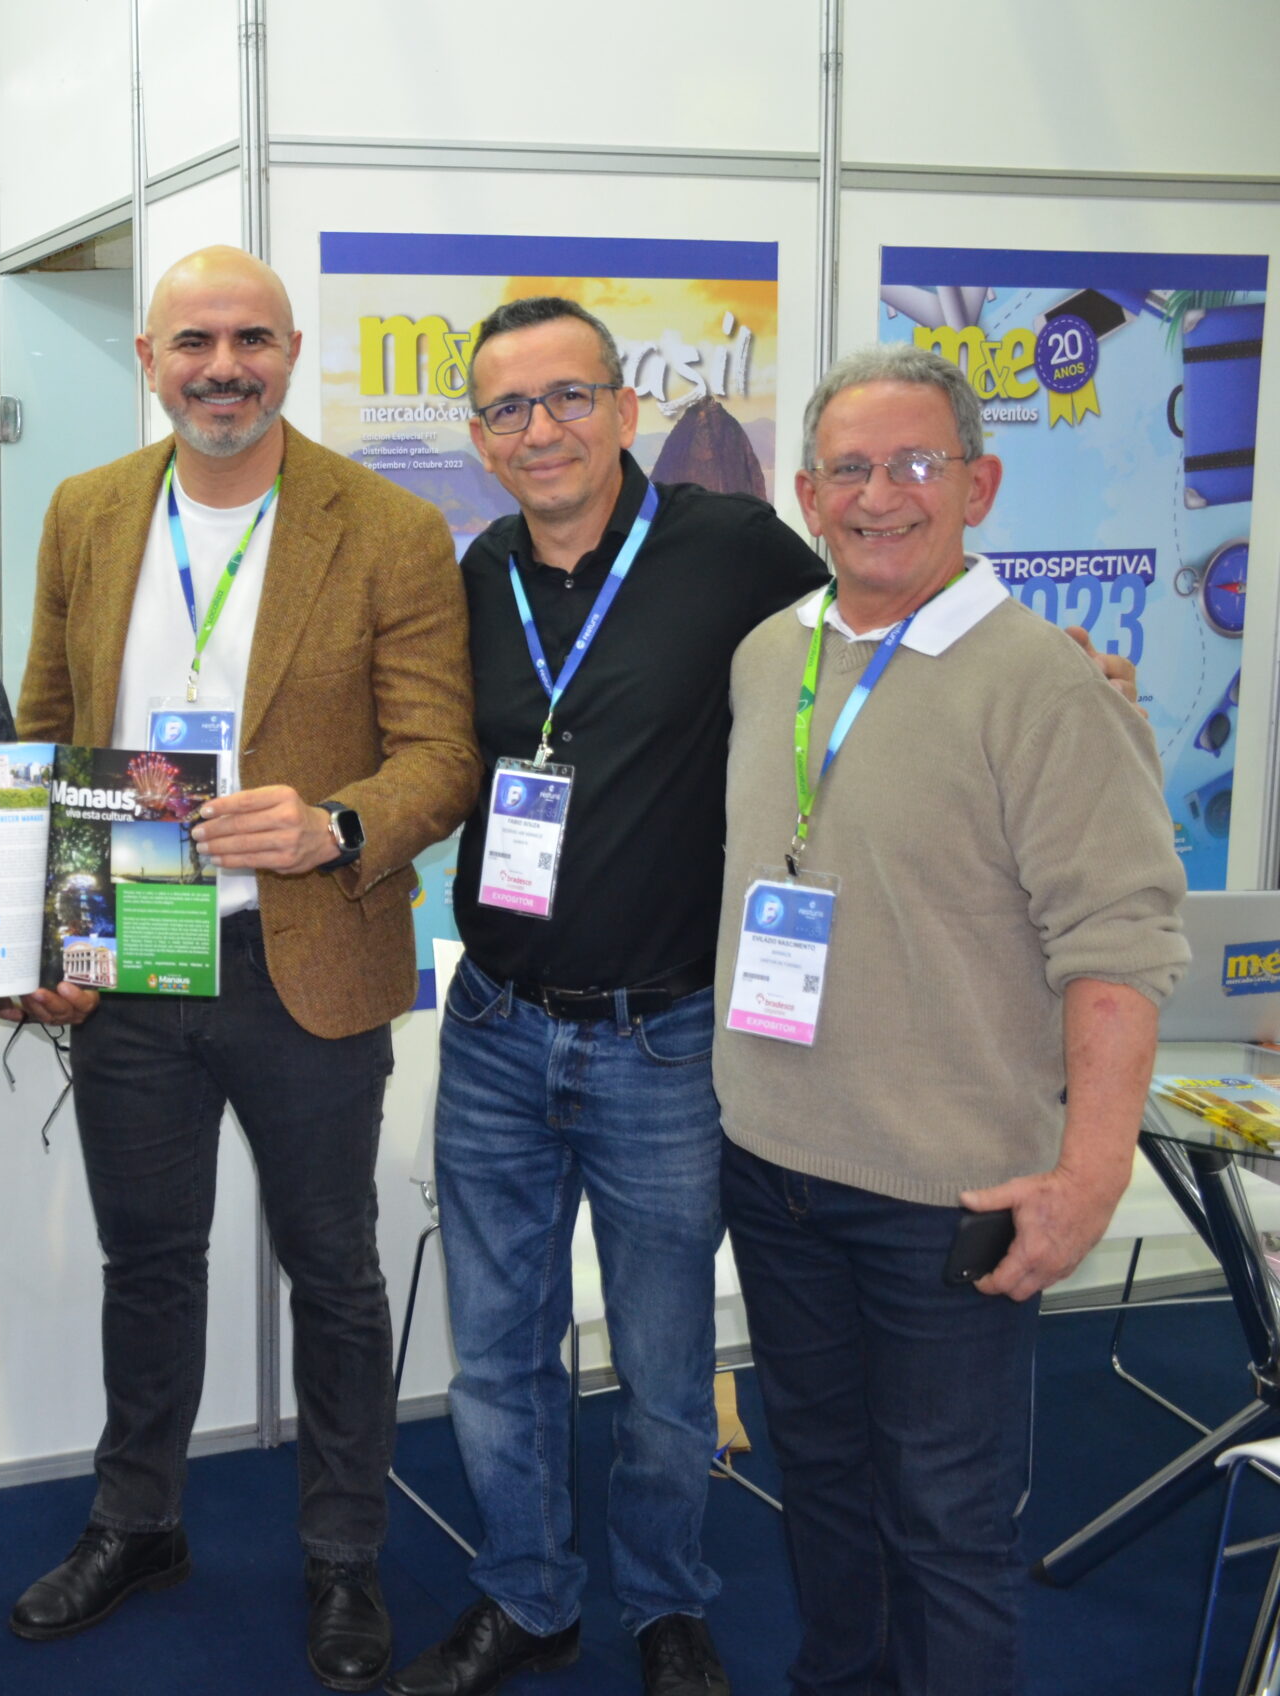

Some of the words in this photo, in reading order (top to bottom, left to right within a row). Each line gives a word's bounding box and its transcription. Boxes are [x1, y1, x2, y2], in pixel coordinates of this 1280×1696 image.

[1048, 329, 1082, 365] 20
[1053, 362, 1086, 380] ANOS
[392, 432, 423, 442] Especial
[362, 446, 409, 455] Distribución
[409, 447, 439, 456] gratuita
[362, 461, 406, 471] Septiembre
[412, 460, 442, 469] Octubre
[443, 460, 463, 468] 2023
[992, 554, 1153, 579] ETROSPECTIVA
[51, 779, 142, 817] Manaus,
[65, 808, 81, 819] viva
[82, 810, 100, 820] esta
[101, 811, 135, 823] cultura.
[491, 892, 534, 907] EXPOSITOR
[745, 1016, 797, 1034] EXPOSITOR
